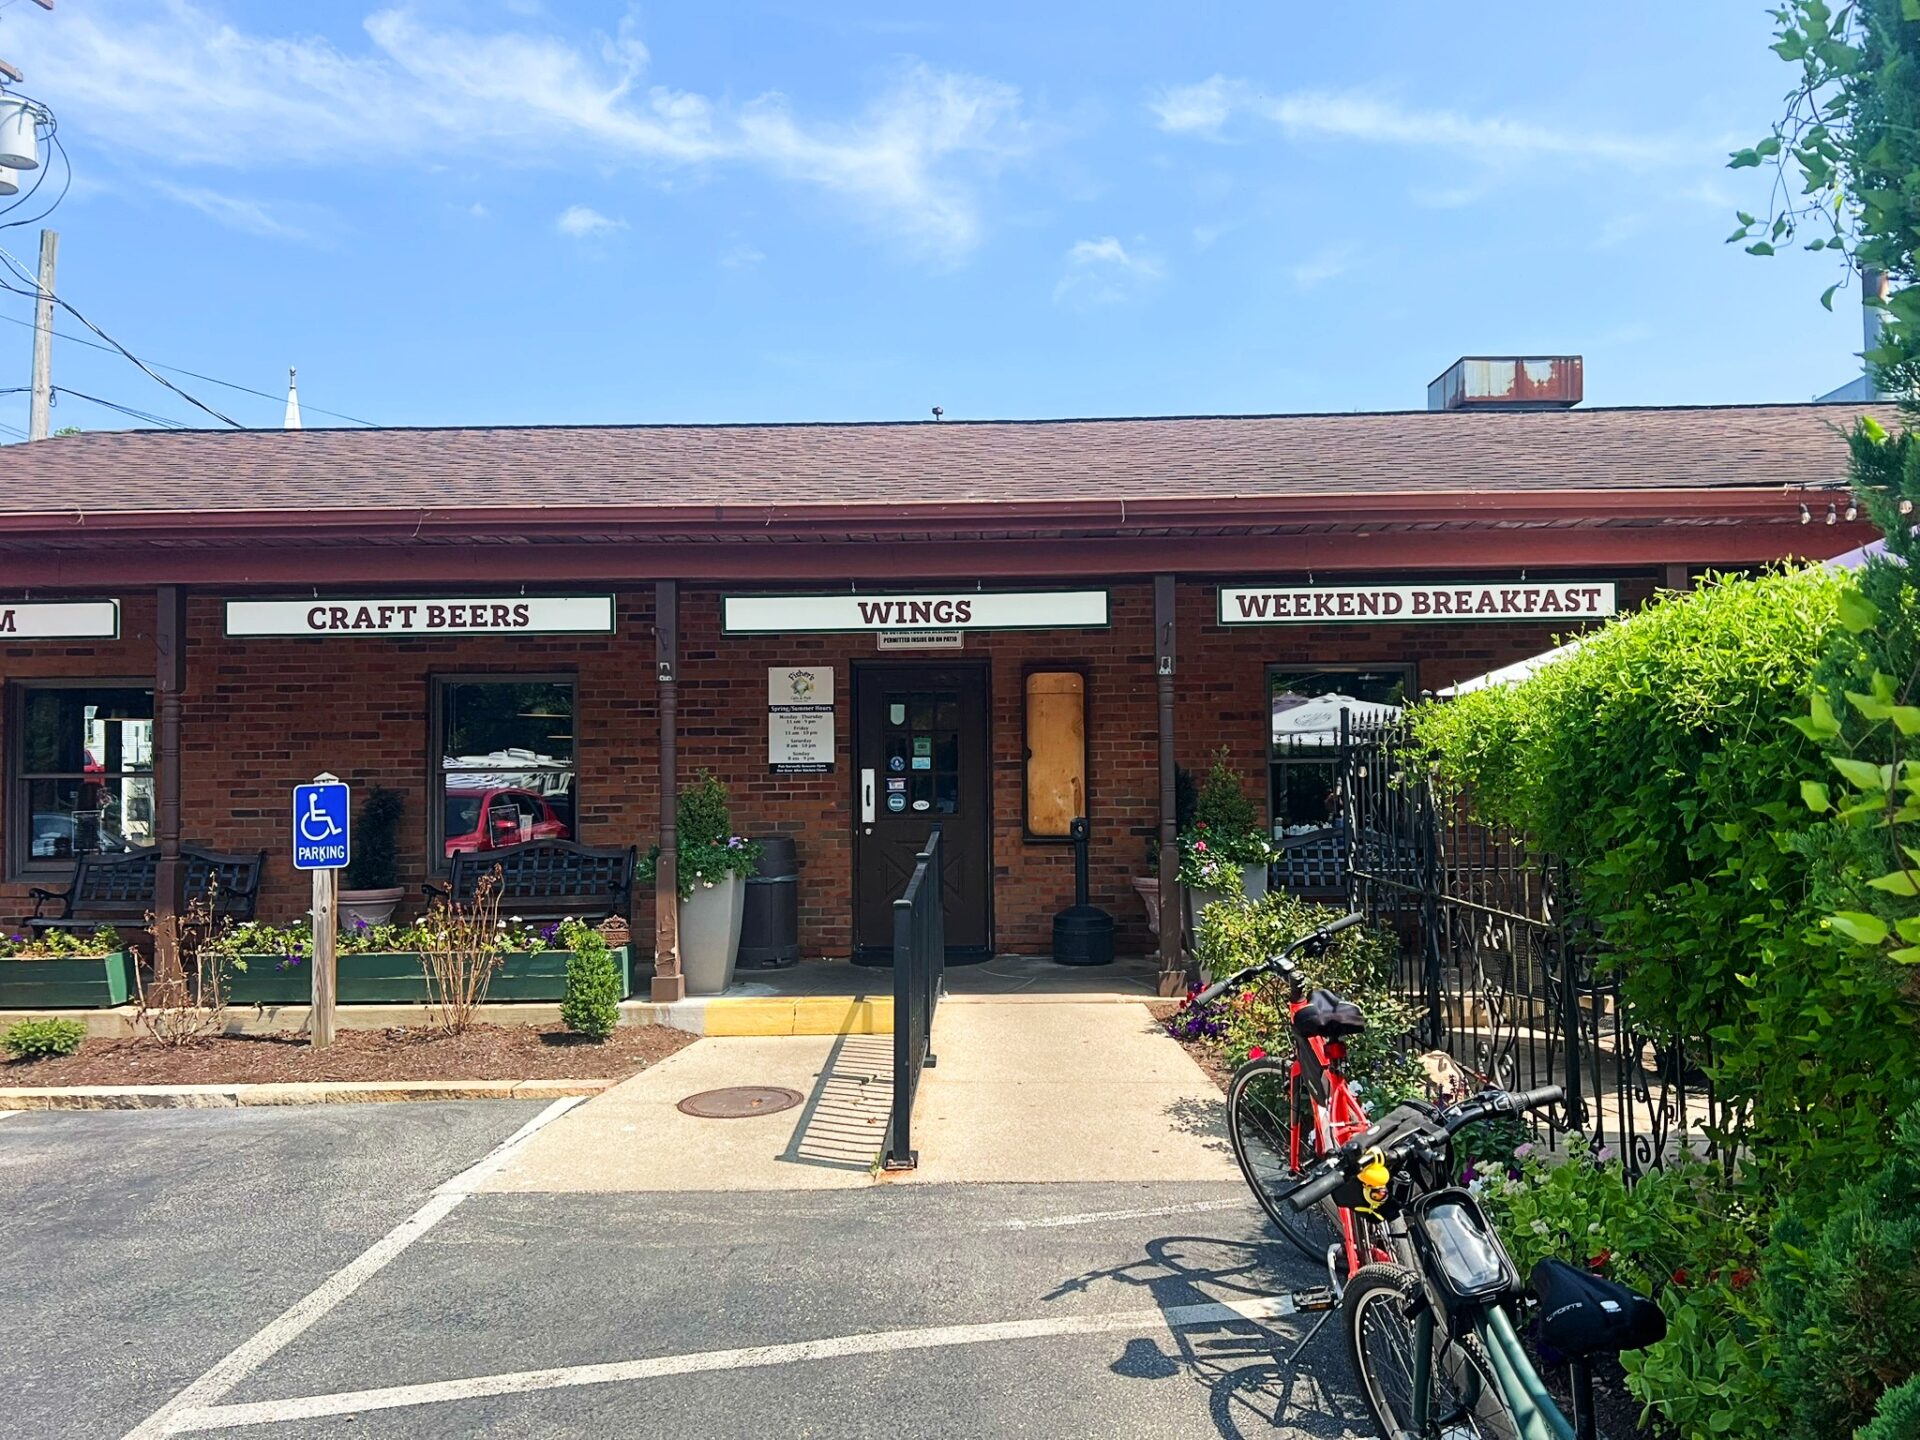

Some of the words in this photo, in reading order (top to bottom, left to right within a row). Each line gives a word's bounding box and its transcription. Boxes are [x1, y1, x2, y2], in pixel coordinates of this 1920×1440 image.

[857, 600, 972, 624] WINGS
[1235, 592, 1403, 618] WEEKEND
[1411, 588, 1602, 615] BREAKFAST
[307, 605, 417, 630] CRAFT
[426, 603, 530, 628] BEERS
[298, 845, 345, 861] PARKING
